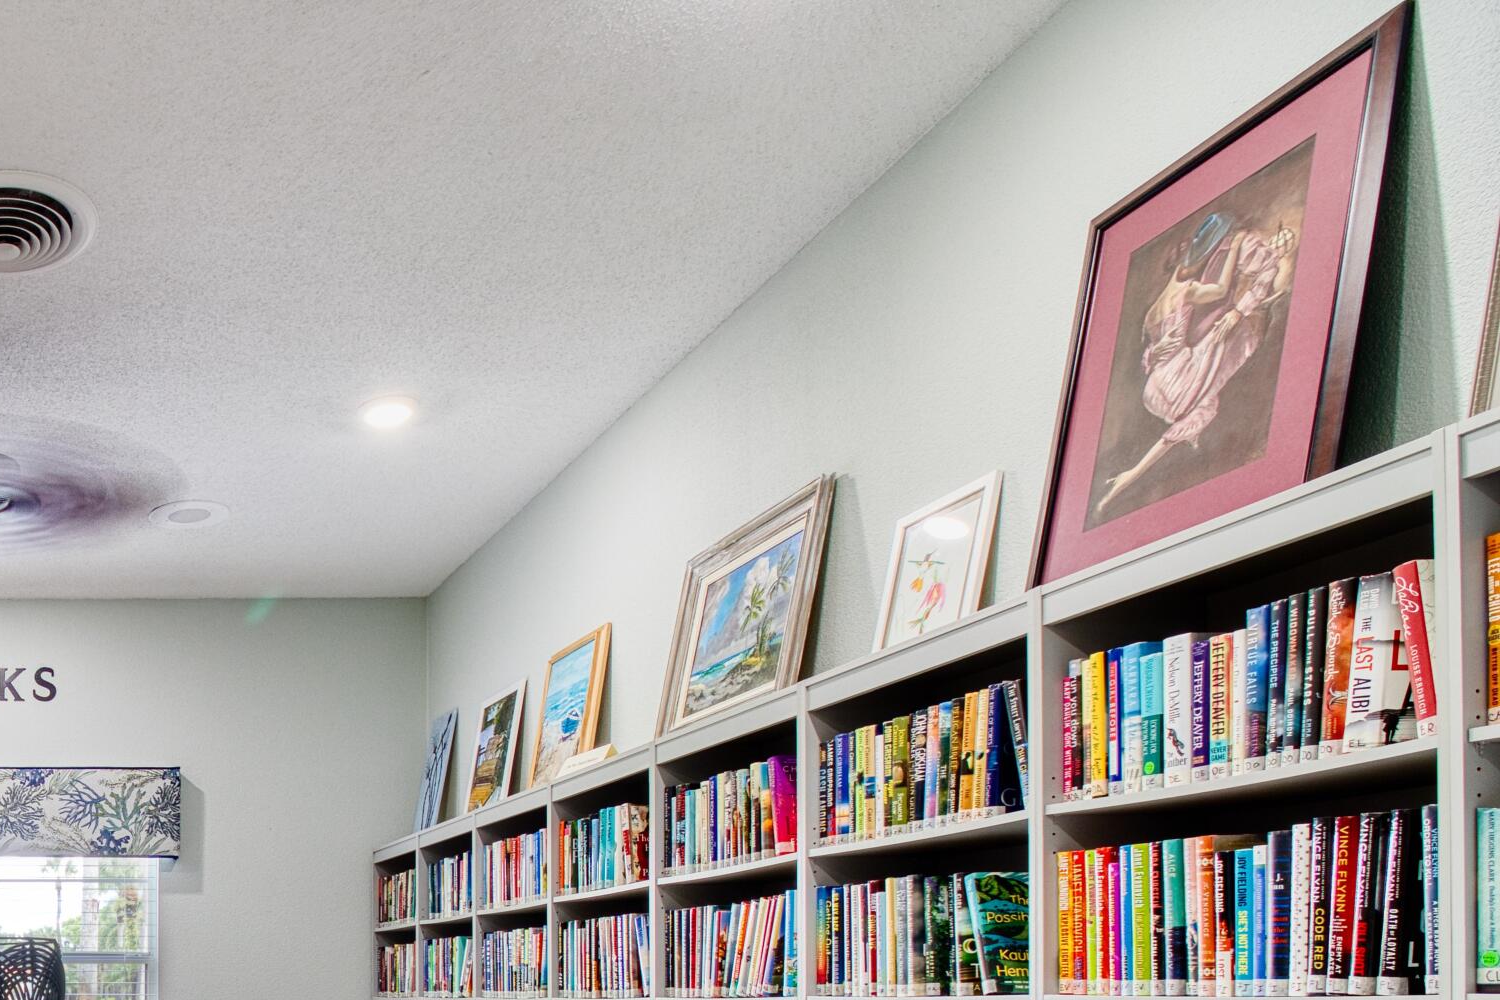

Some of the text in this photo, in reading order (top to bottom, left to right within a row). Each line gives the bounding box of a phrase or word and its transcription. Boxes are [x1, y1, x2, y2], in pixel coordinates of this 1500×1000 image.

[1212, 642, 1225, 735] JEFFERY DEAVER
[1246, 623, 1258, 705] VIRTUE FALLS
[1270, 620, 1279, 689] THE PRECIPICE
[1350, 616, 1375, 714] THE LAST ALIBI
[1394, 576, 1428, 716] LaRose LOUISE ERDRICH
[914, 714, 927, 783] JOHN GRISHAM
[950, 706, 960, 770] PELICAN BRIEF
[1008, 684, 1023, 742] THE STREET LAWYER
[1193, 660, 1204, 751] JEFFERY DEAVER
[1073, 863, 1083, 953] JANET EVANOVICH
[1312, 823, 1325, 971] VINCE FLYNN CODE RED
[1336, 825, 1350, 913] VINCE FLYNN
[1354, 817, 1371, 978] VINCE FLYNN KILL SHOT
[1237, 856, 1249, 976] JOY FIELDING SHE'S NOT THERE
[1334, 935, 1344, 975] ENEMY AT
